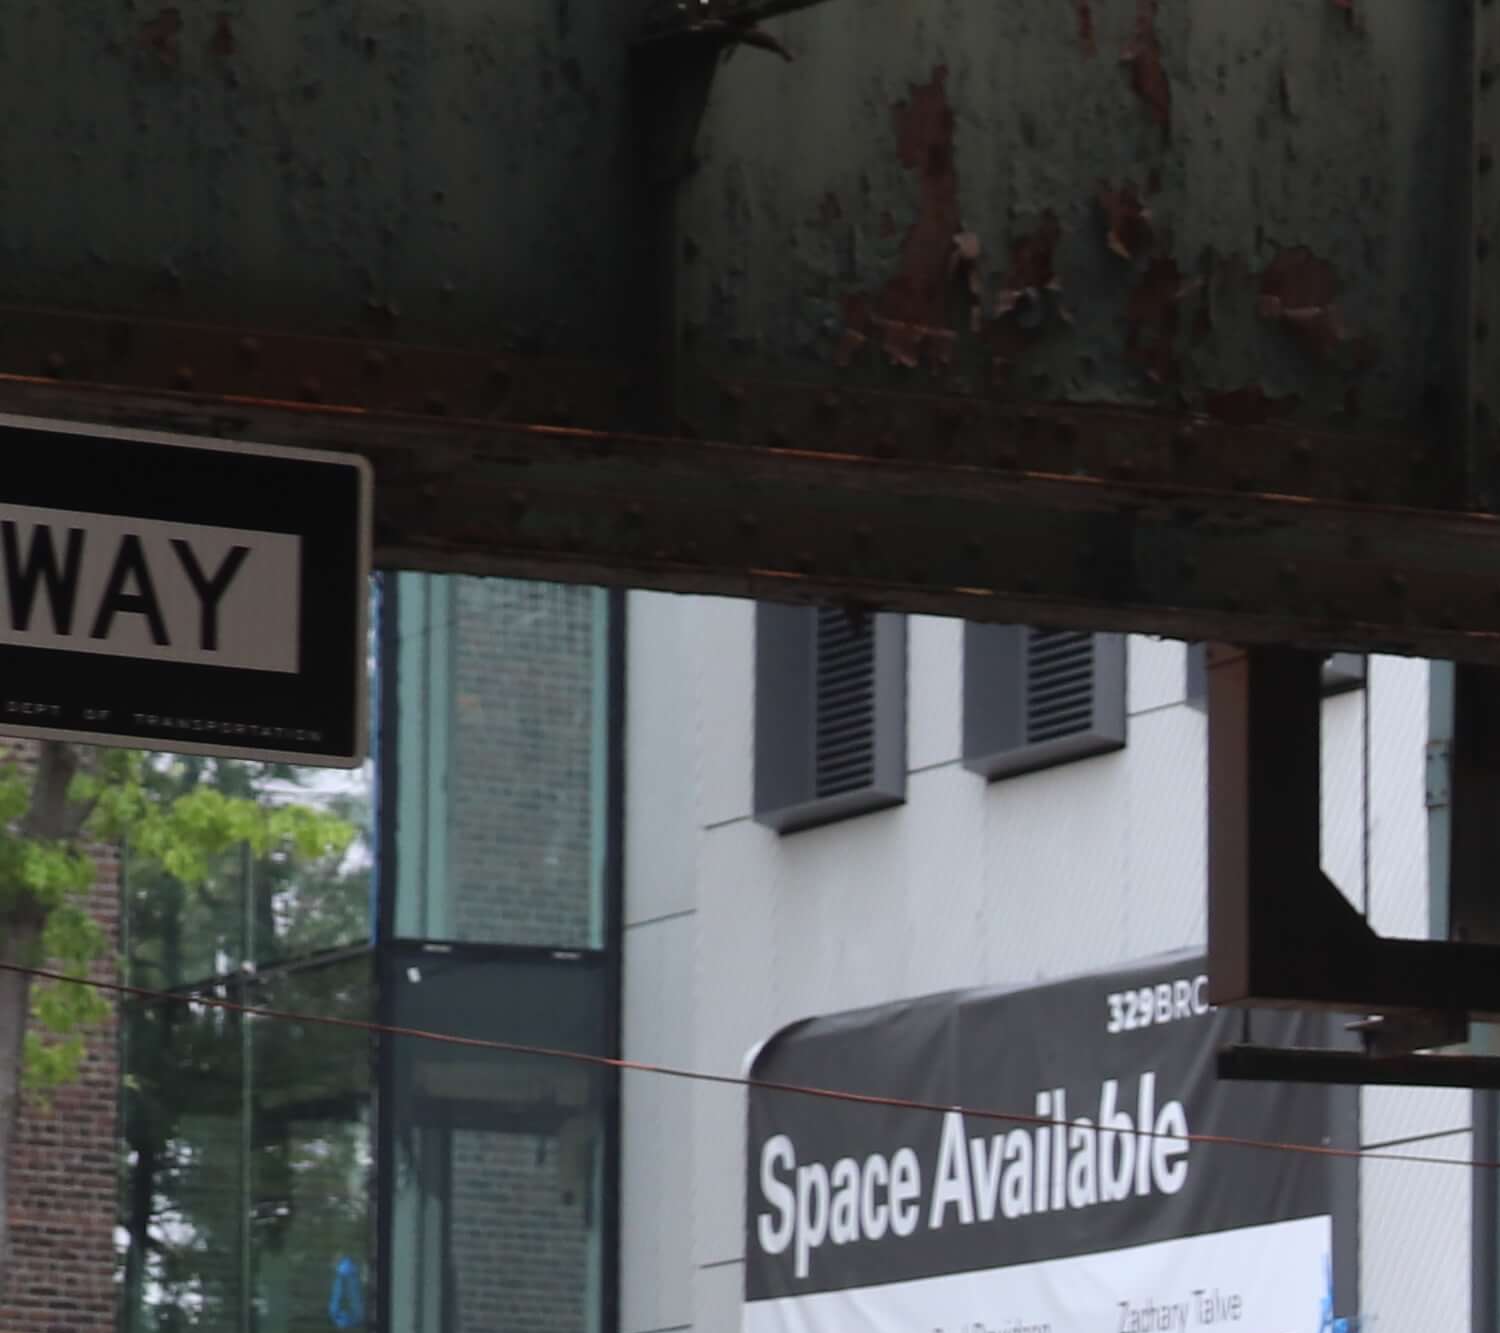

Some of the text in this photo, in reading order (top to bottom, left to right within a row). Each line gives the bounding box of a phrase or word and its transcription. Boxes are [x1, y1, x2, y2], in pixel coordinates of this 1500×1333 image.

[0, 520, 251, 651] WAY
[1107, 975, 1217, 1032] 329BRO
[757, 1071, 1189, 1278] Space Available
